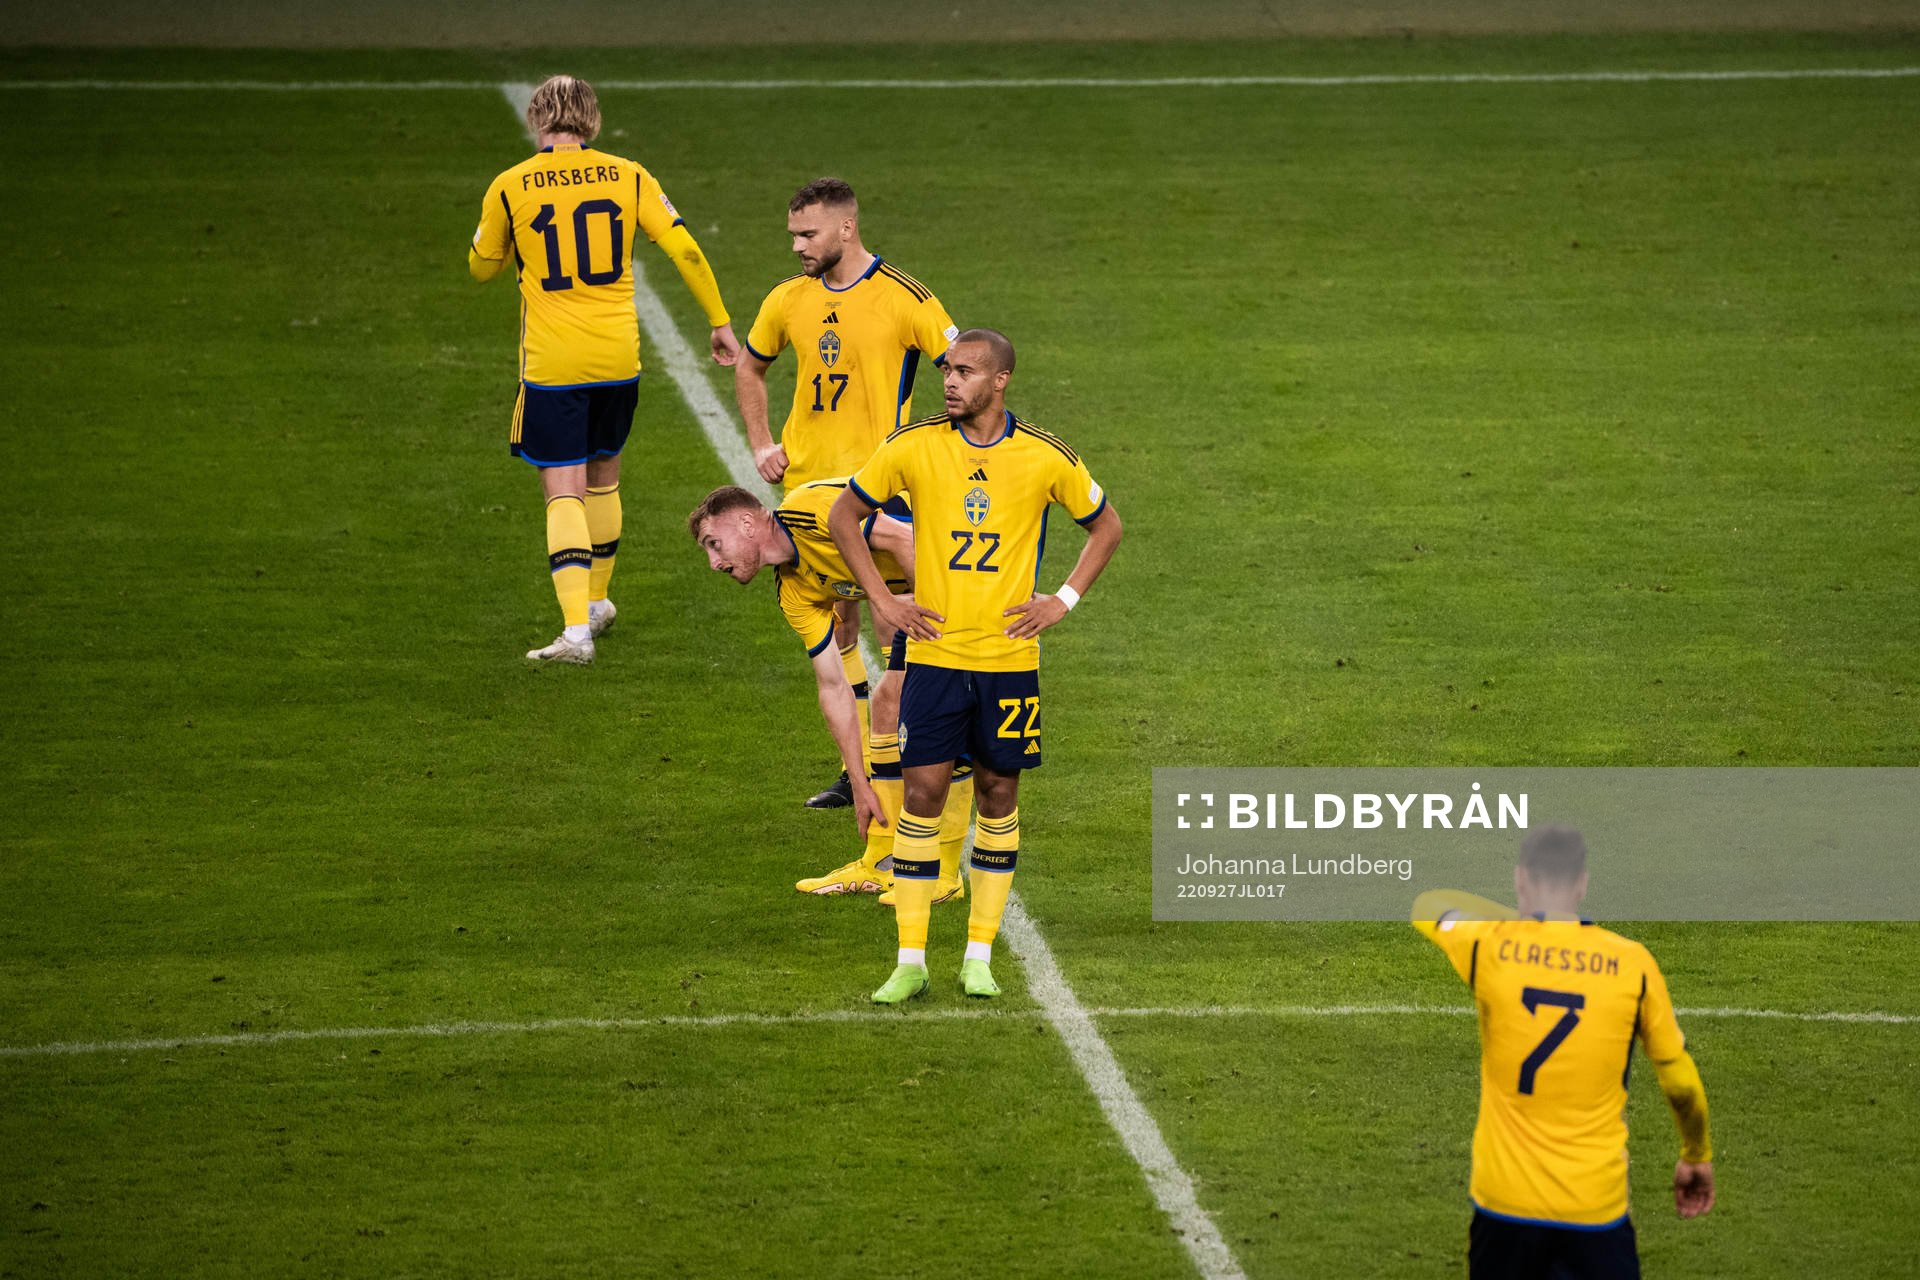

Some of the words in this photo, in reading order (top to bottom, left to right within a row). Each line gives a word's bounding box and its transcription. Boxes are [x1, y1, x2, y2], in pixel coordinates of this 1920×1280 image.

[522, 166, 619, 191] FORSBERG
[530, 199, 623, 291] 10
[812, 373, 848, 411] 17
[949, 530, 1000, 572] 22
[997, 696, 1040, 738] 22
[1499, 940, 1620, 976] CLAESSON
[1518, 986, 1585, 1095] 7
